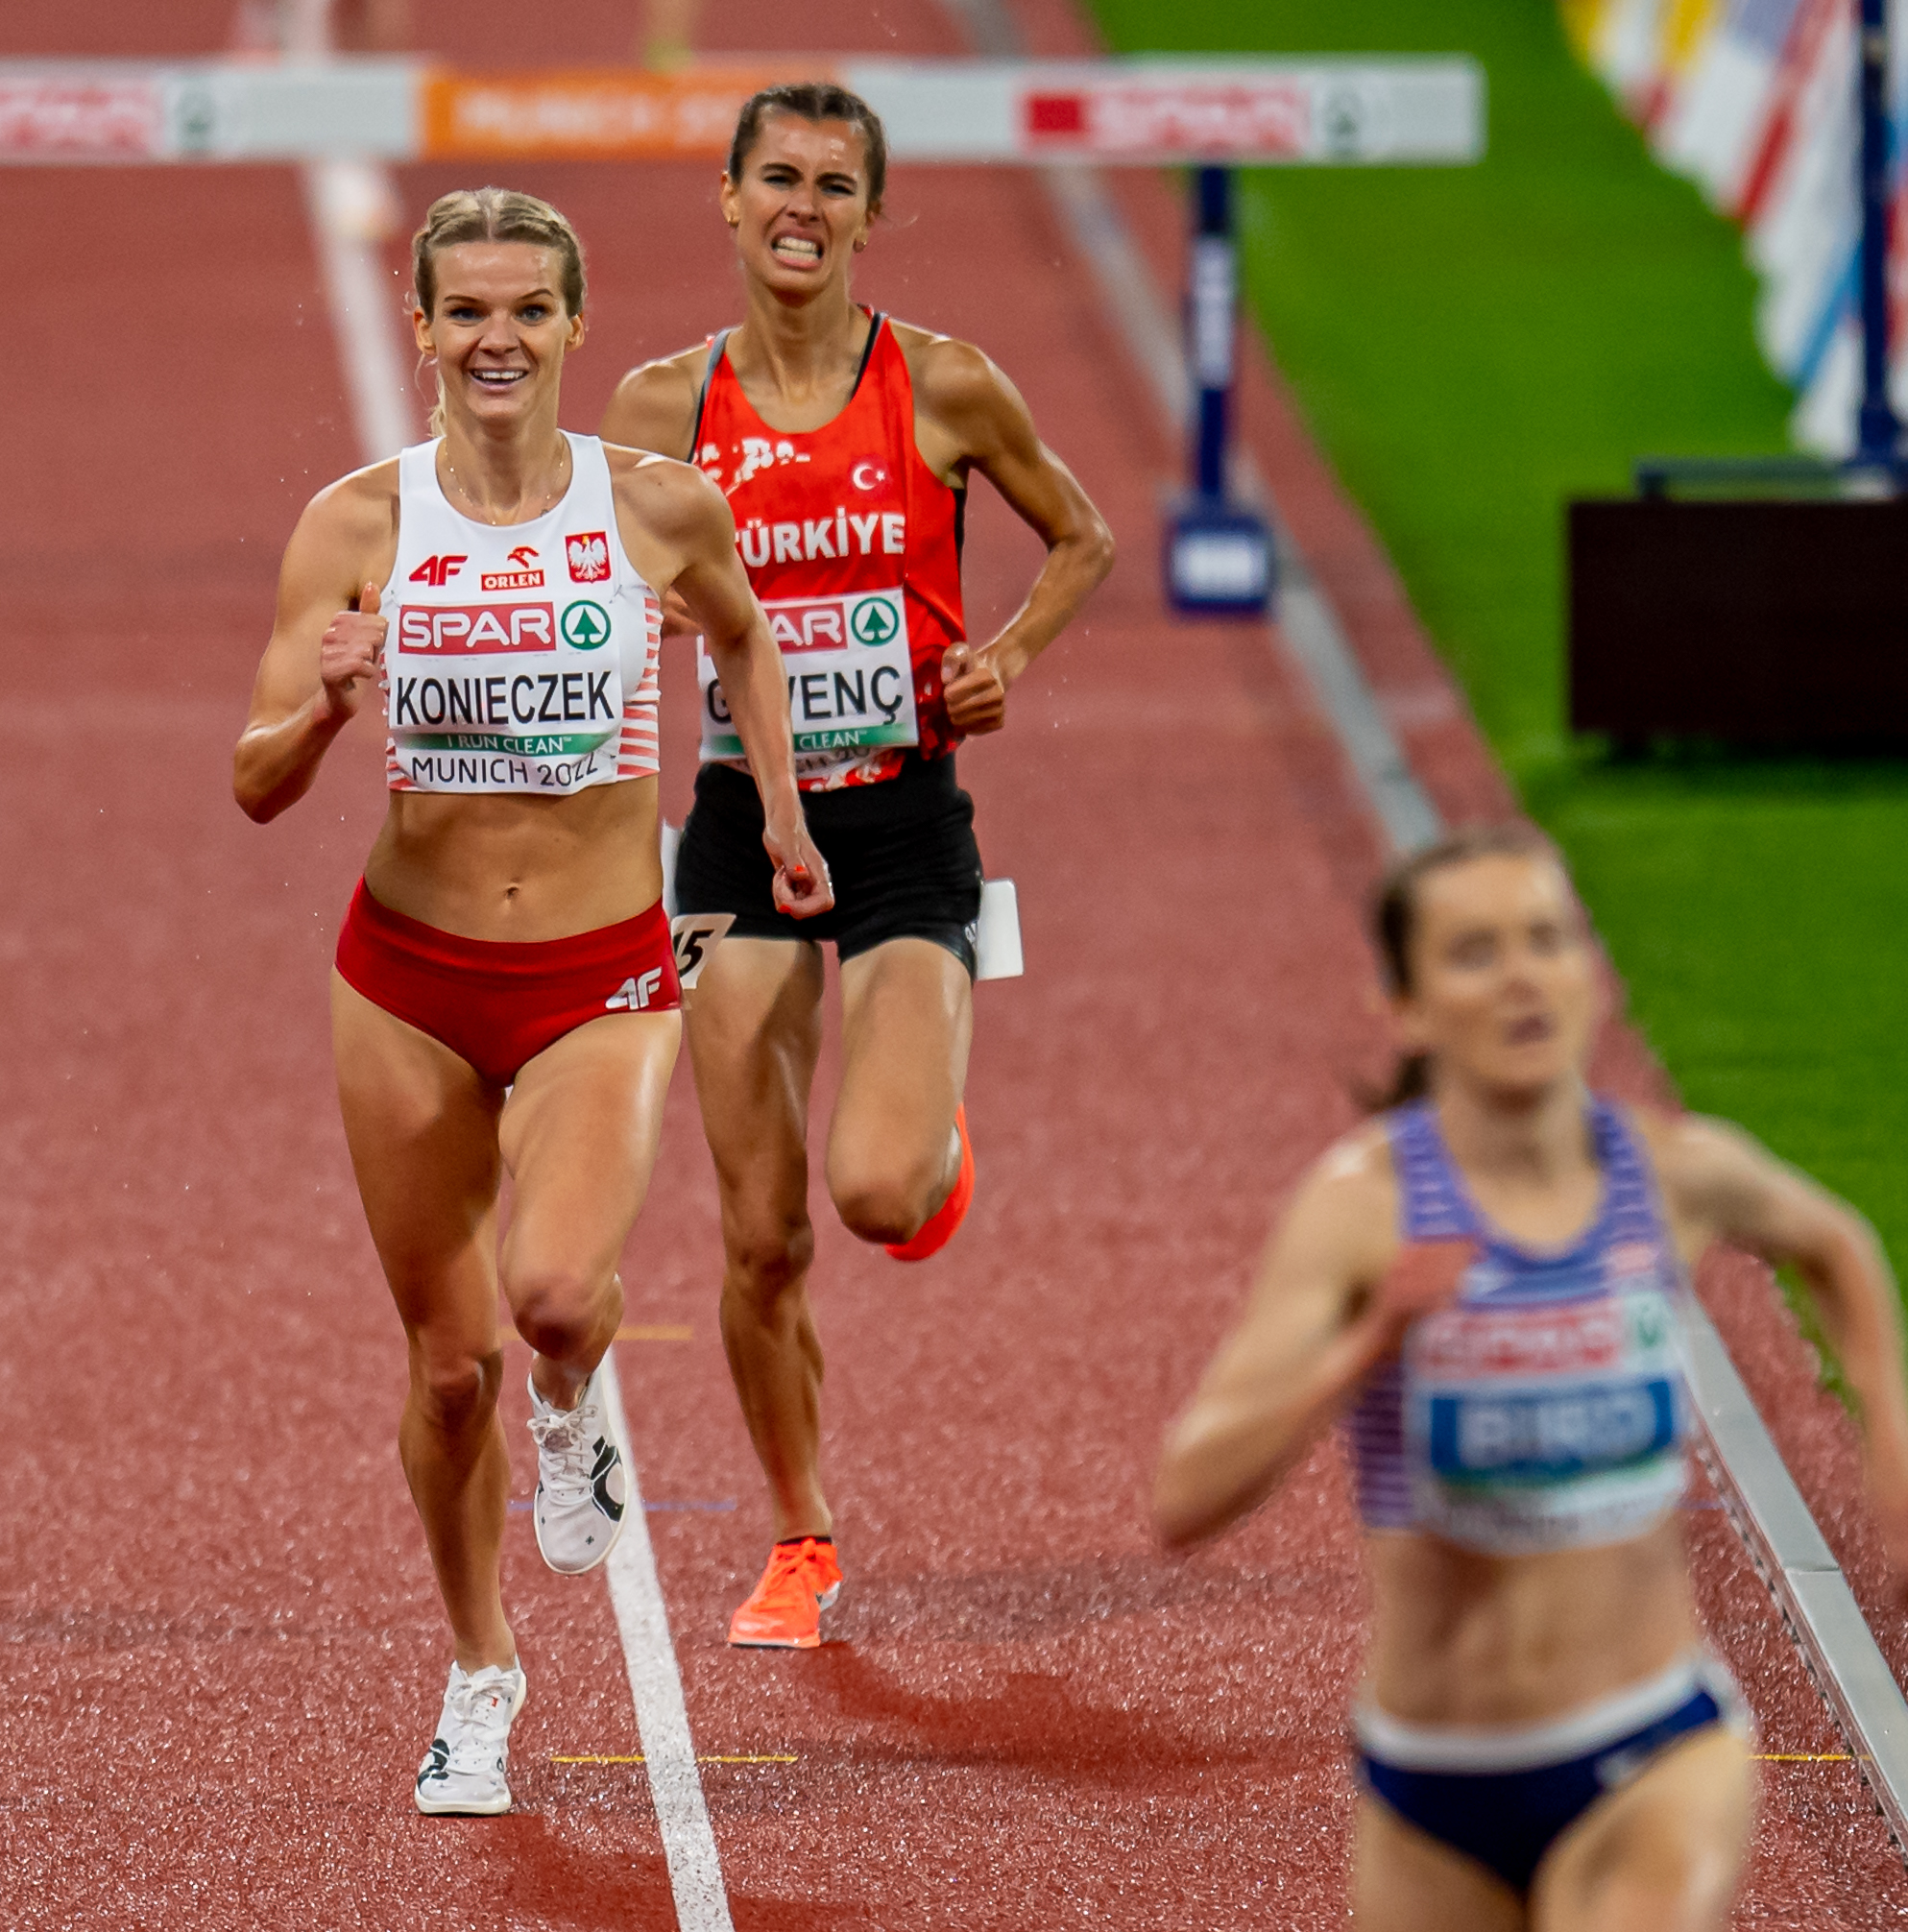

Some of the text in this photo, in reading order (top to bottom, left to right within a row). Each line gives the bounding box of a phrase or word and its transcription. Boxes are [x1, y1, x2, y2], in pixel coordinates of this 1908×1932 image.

[409, 554, 469, 587] 4F
[484, 571, 542, 589] ORLEN
[401, 609, 551, 648] SPAR
[396, 670, 615, 726] KONIECZEK
[458, 735, 498, 750] RUN
[412, 751, 599, 786] MUNICH 2022
